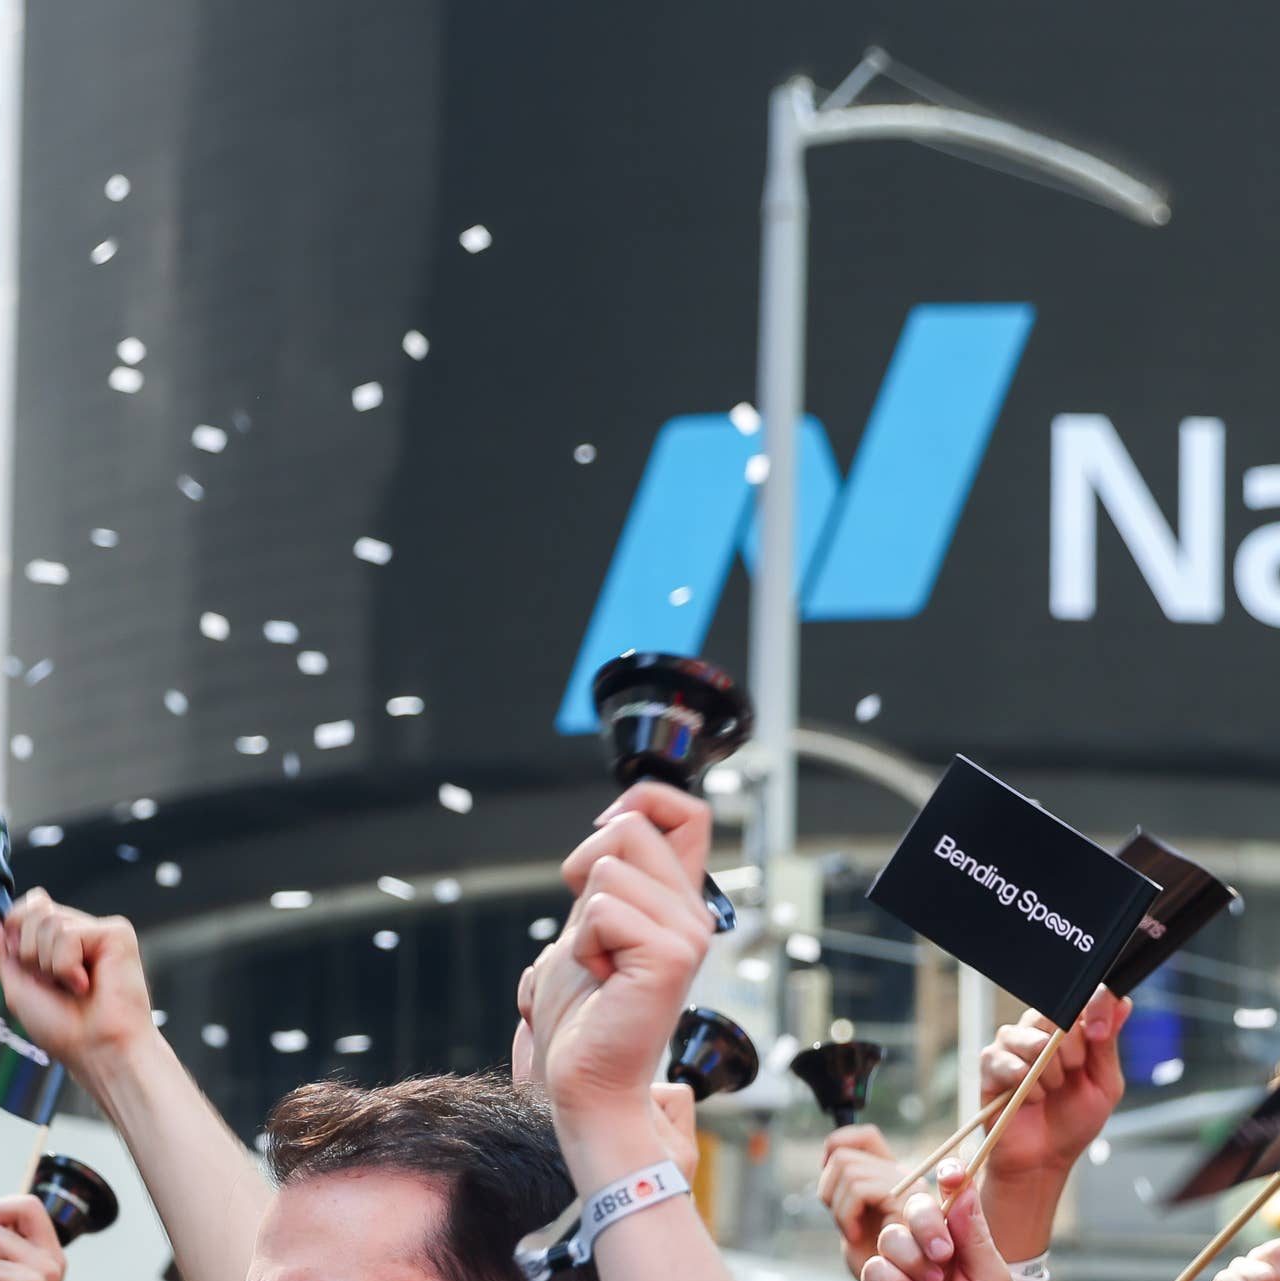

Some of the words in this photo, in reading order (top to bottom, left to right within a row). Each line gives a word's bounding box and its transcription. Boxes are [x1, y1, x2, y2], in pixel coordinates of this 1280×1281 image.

[933, 834, 1019, 906] Bending
[1017, 890, 1095, 952] Spoons
[653, 1173, 665, 1191] I
[592, 1187, 633, 1223] BSP
